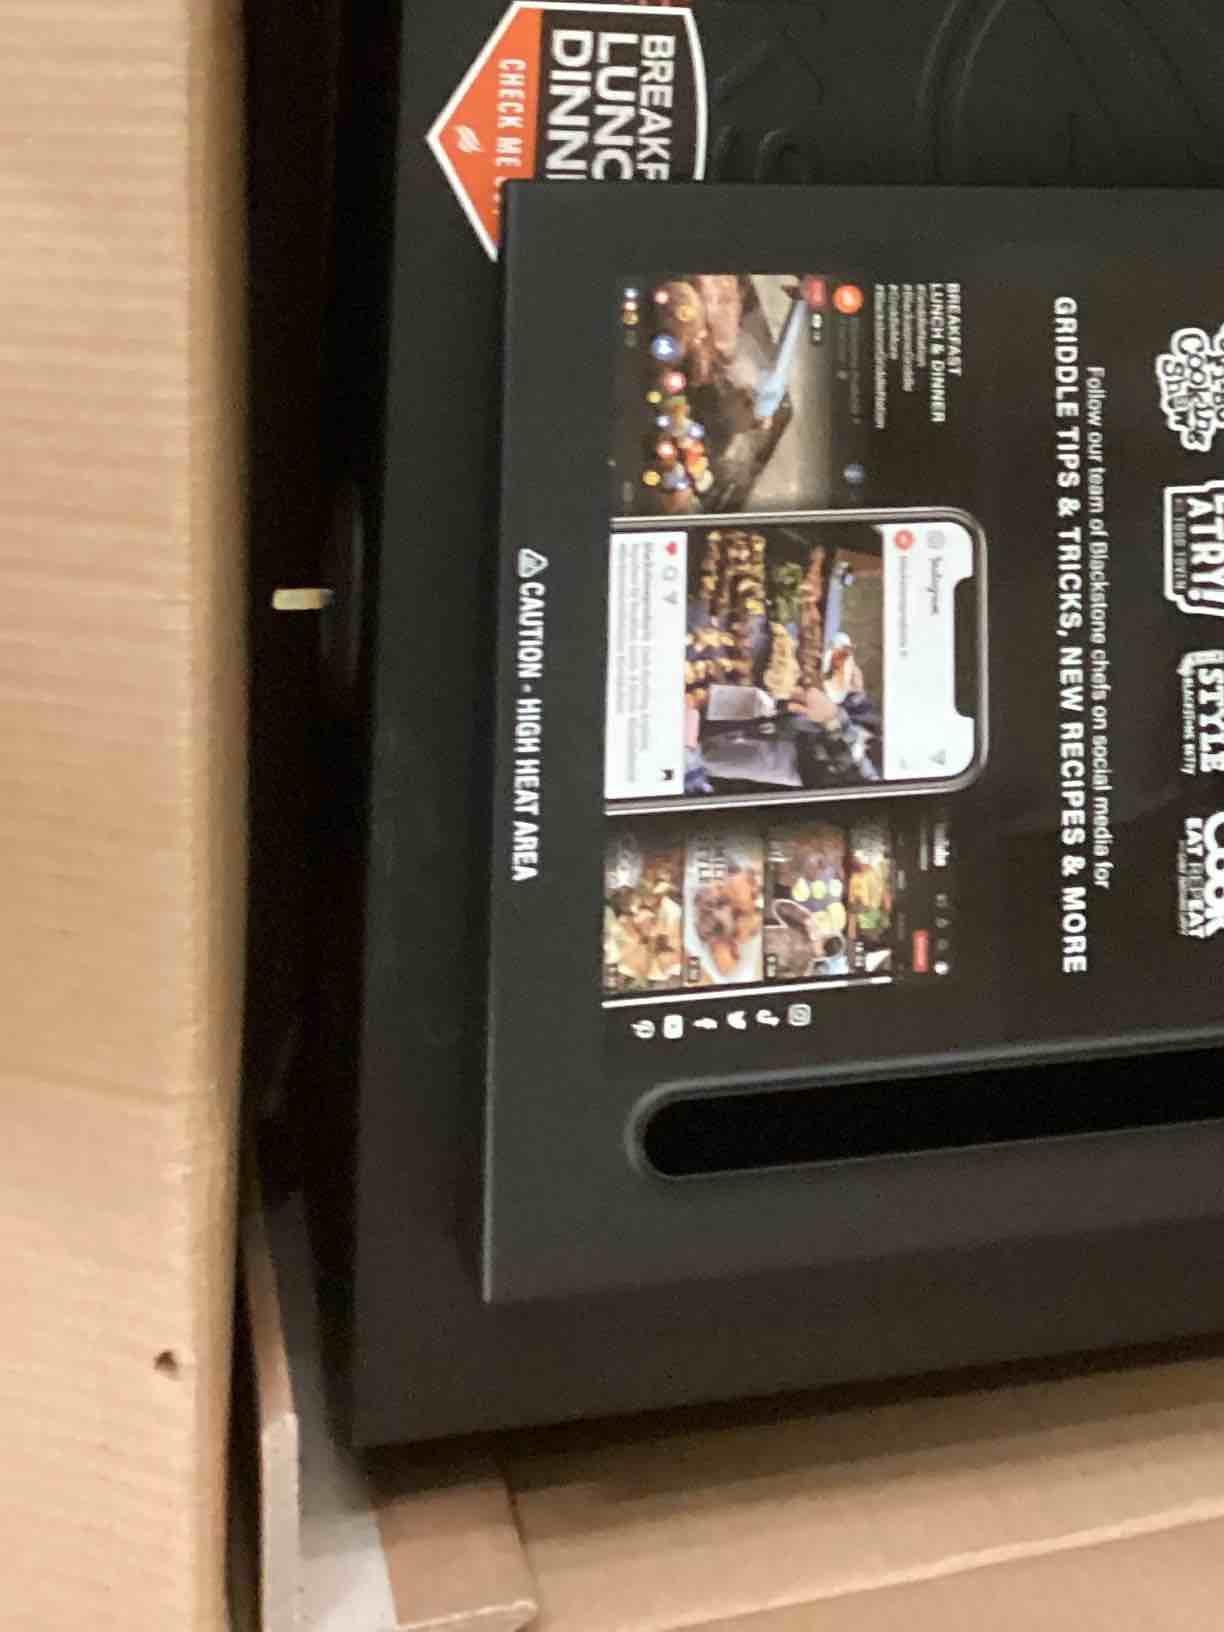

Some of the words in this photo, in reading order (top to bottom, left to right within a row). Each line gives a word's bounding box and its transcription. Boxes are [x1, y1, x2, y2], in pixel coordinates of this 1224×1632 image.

[497, 59, 527, 128] CHECK
[546, 29, 594, 180] DINN
[495, 136, 524, 168] ME
[929, 282, 946, 339] LUNCH
[947, 282, 963, 377] BREAKFAST
[1054, 296, 1080, 418] GRIDDLE
[930, 359, 947, 423] DINNER
[1086, 366, 1108, 429] Follow
[1176, 331, 1215, 448] Cooking
[1056, 426, 1081, 488] TIPS
[1087, 431, 1105, 462] our
[1057, 497, 1082, 518] &
[1087, 467, 1107, 513] team
[1088, 518, 1109, 537] of
[1056, 526, 1084, 637] TRICKS,
[1088, 541, 1110, 643] Blackstone
[517, 581, 545, 678] CAUTION
[1059, 646, 1085, 712] NEW
[1090, 649, 1112, 700] chefs
[514, 698, 542, 753] HIGH
[1091, 705, 1108, 730] on
[513, 759, 541, 815] HEAT
[1059, 721, 1087, 846] RECIPES
[1091, 734, 1113, 791] social
[511, 820, 539, 881] AREA
[1092, 796, 1113, 857] media
[1061, 855, 1087, 877] &
[1093, 861, 1114, 889] for
[1061, 886, 1088, 974] MORE
